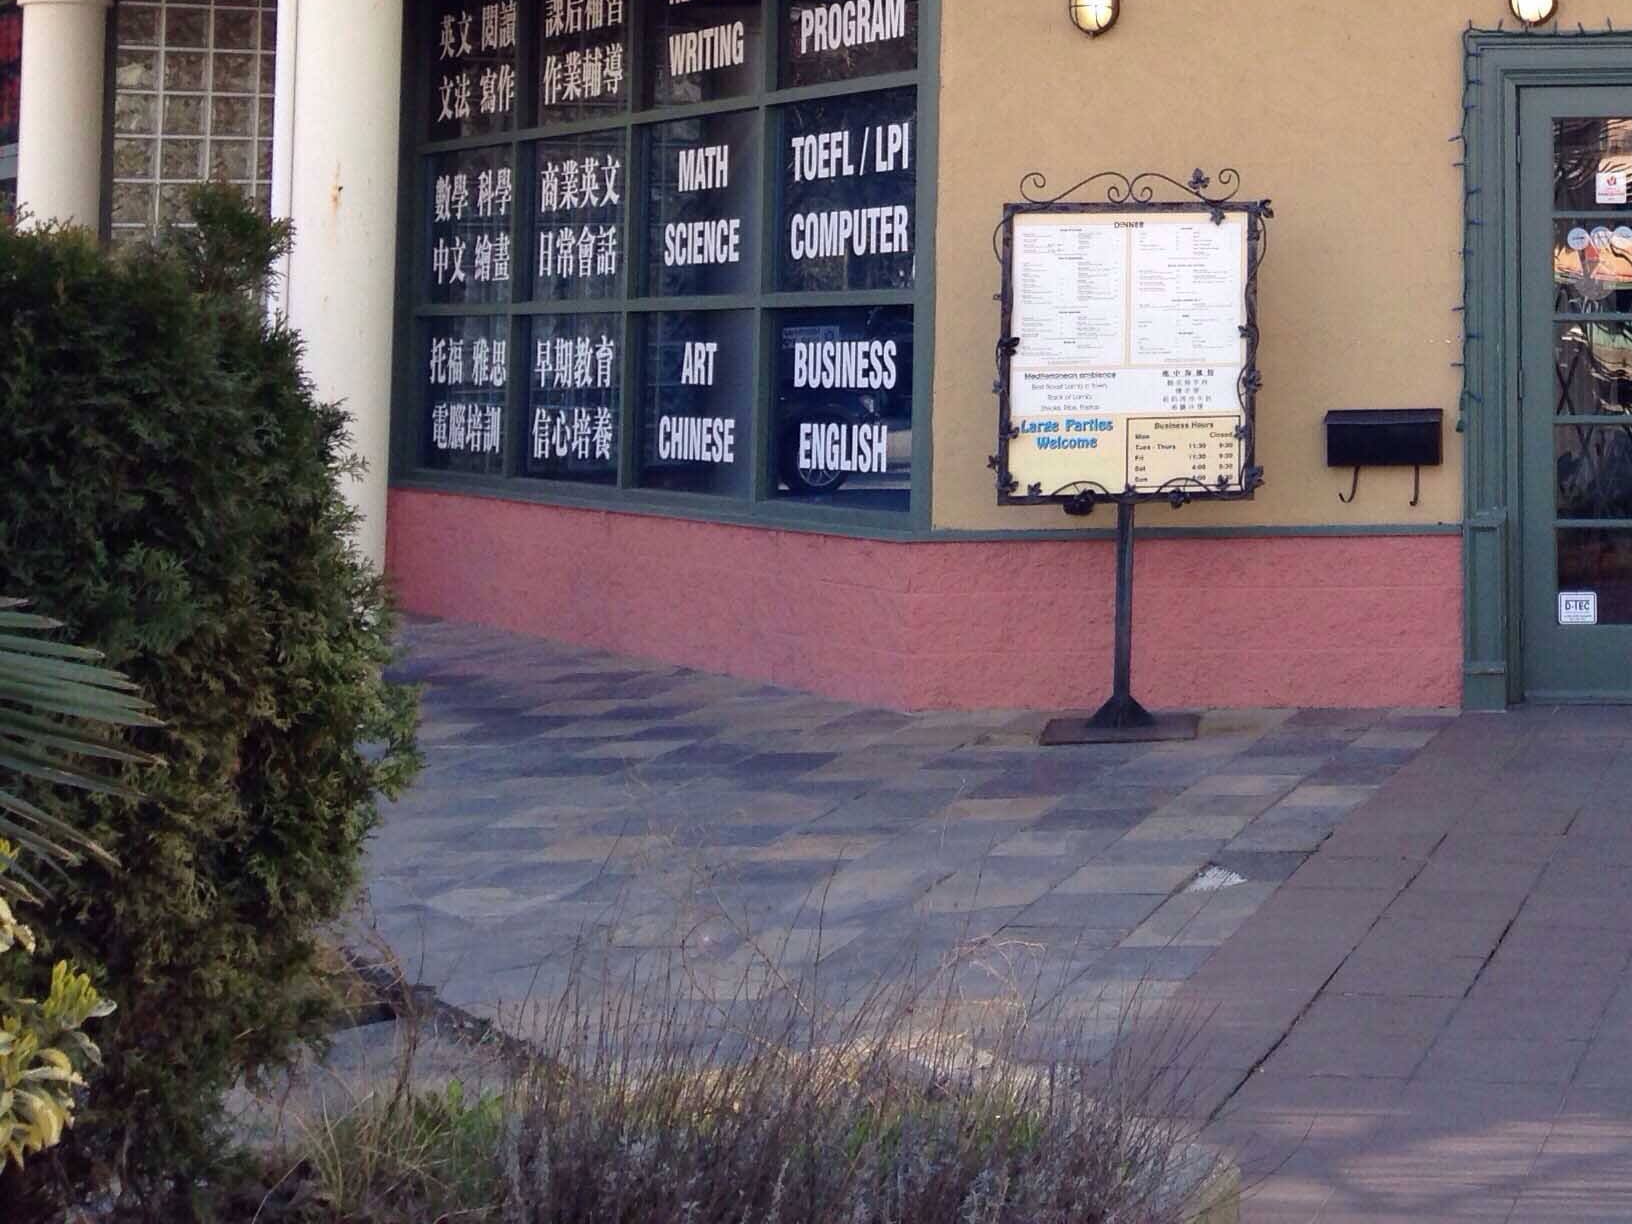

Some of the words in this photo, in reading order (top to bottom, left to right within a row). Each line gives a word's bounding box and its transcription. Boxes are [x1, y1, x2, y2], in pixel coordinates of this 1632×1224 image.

[439, 10, 472, 61] 英文
[668, 21, 744, 76] WRITING
[438, 73, 471, 122] 文法
[479, 64, 515, 114] 寫作
[543, 42, 624, 106] 作業輔導
[678, 145, 729, 192] MATH
[791, 130, 854, 182] TOEFL
[875, 122, 909, 172] LPI
[434, 173, 468, 223] 數學
[476, 167, 512, 217] 科學
[540, 153, 622, 213] 商業英文
[433, 236, 466, 285] 中文
[474, 231, 511, 282] 繪畫
[539, 225, 617, 279] 日常會話
[664, 219, 740, 266] SCIENCE
[790, 205, 908, 260] COMPUTER
[429, 337, 463, 385] 托福
[472, 338, 506, 387] 雅思
[534, 334, 615, 388] 早期教育
[681, 341, 718, 386] ART
[793, 340, 897, 390] BUSINESS
[432, 403, 501, 454] 電腦培訓
[532, 406, 612, 460] 信心培養
[658, 416, 735, 463] CHINESE
[799, 423, 888, 473] ENGLISH
[1020, 419, 1060, 433] Large
[1065, 418, 1114, 432] Parties
[1036, 436, 1098, 450] Welcome
